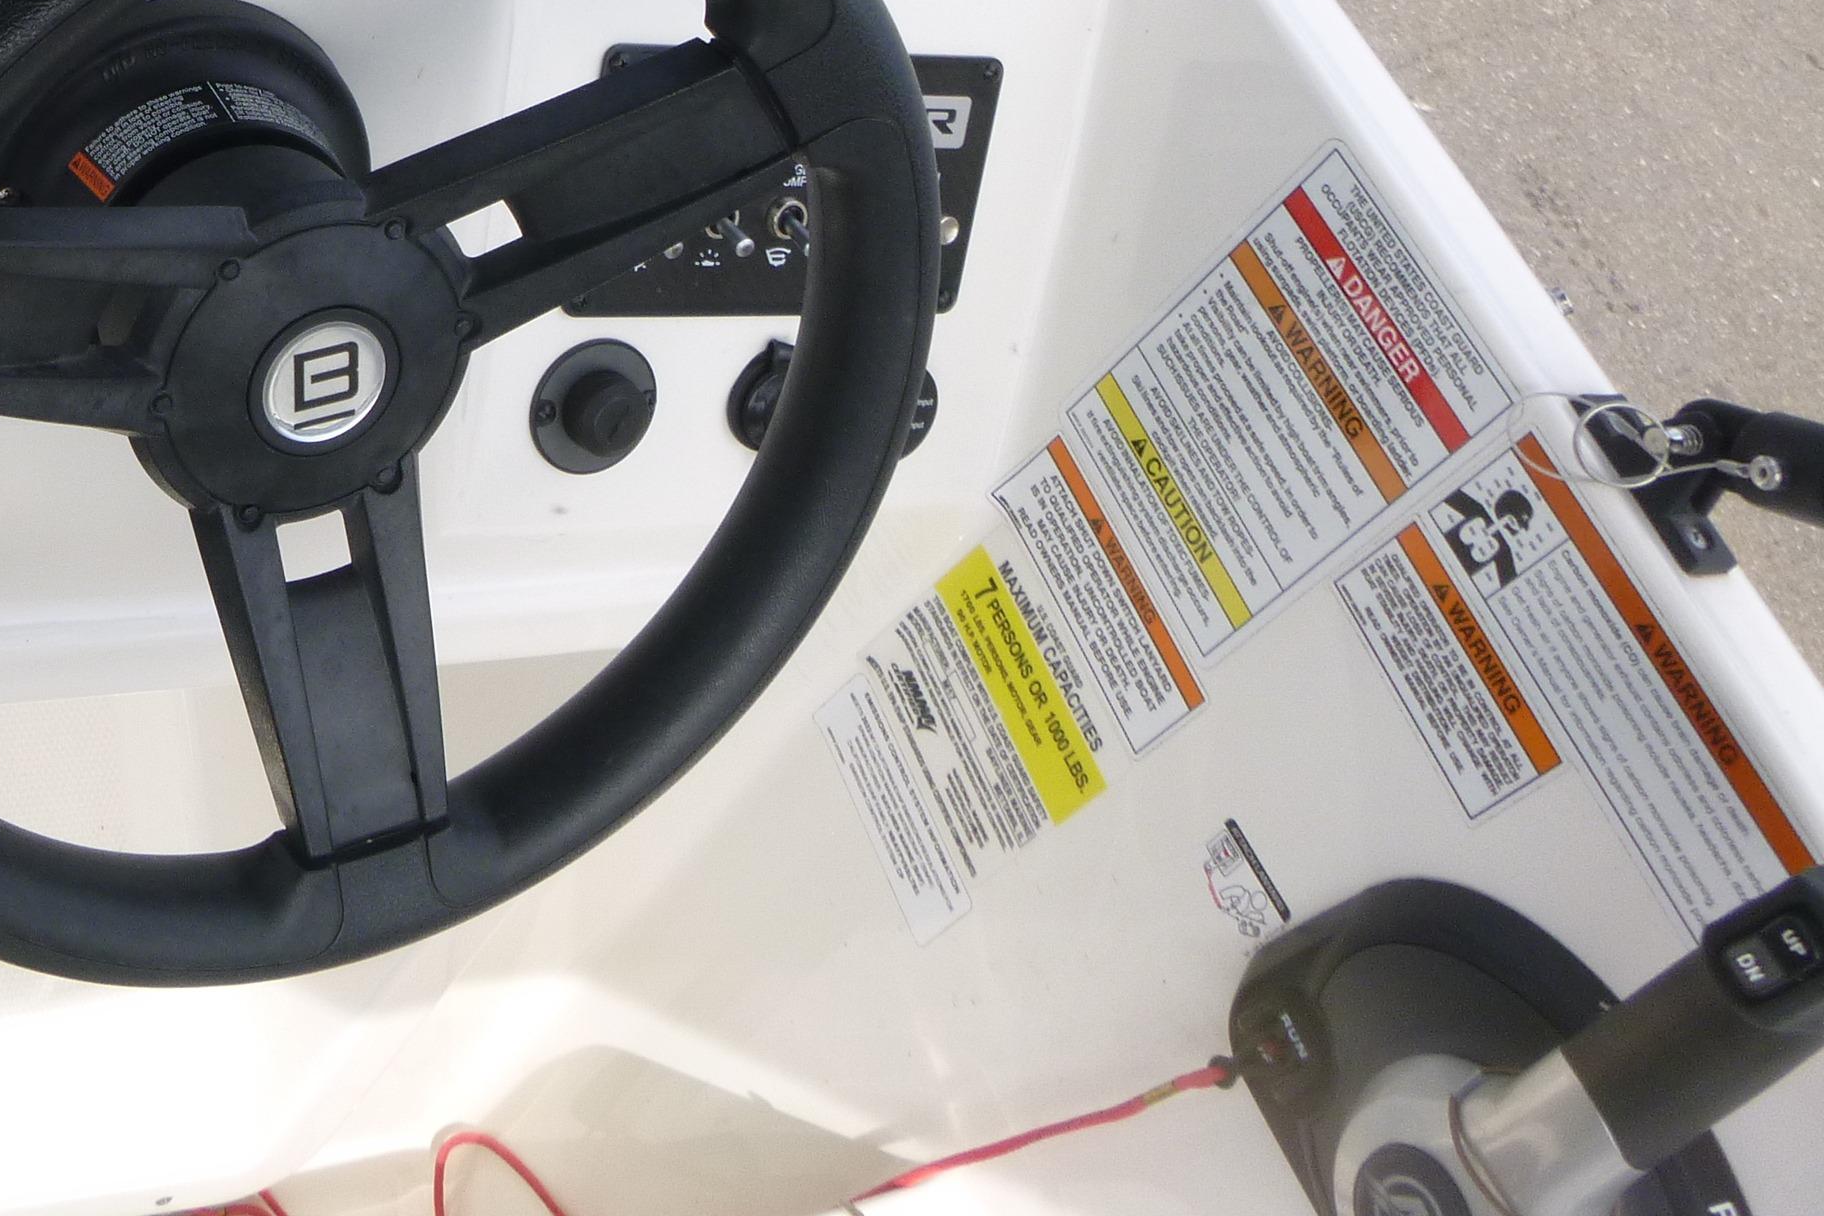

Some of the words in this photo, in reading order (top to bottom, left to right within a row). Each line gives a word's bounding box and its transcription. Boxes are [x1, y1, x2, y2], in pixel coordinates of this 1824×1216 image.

[1293, 235, 1351, 318] PROPELLER(S)
[1345, 313, 1367, 341] MAY
[1361, 336, 1393, 380] CAUSE
[1386, 374, 1426, 428] SERIOUS
[1315, 289, 1346, 331] INJURY
[1340, 327, 1357, 348] OR
[1319, 183, 1369, 251] OCCUPANTS
[1365, 249, 1392, 285] WEAR
[1389, 284, 1435, 347] APPROVED
[1431, 345, 1479, 410] PERSONAL
[1336, 227, 1381, 290] FLOTATION
[1376, 287, 1415, 339] DEVICES
[1341, 274, 1422, 384] DANGER
[1345, 200, 1376, 241] (USCG)
[1372, 238, 1431, 320] RECOMMENDS
[1427, 318, 1453, 351] THAT
[1448, 350, 1470, 376] ALL
[1348, 184, 1369, 210] THE
[1365, 208, 1397, 251] UNITED
[1392, 248, 1426, 292] STATES
[1422, 290, 1454, 332] COAST
[1450, 330, 1484, 376] GUARD
[1265, 328, 1291, 365] AVOID
[1283, 322, 1366, 440] WARNING
[1102, 417, 1124, 452] AVOID
[1120, 449, 1161, 515] INHALATION
[1156, 511, 1169, 528] OF
[1165, 527, 1188, 561] TOXIC
[1143, 454, 1213, 564] CAUTION
[1150, 385, 1172, 419] AVOID
[1168, 416, 1183, 438] SKI
[1179, 434, 1201, 467] LINES
[1198, 466, 1215, 491] AND
[1212, 489, 1231, 517] TOW
[972, 575, 998, 604] 7
[1016, 507, 1037, 539] READ
[1061, 590, 1091, 641] MANUAL
[1088, 641, 1118, 691] BEFORE
[1029, 484, 1040, 498] IS
[1036, 496, 1047, 511] IN
[1082, 582, 1138, 678] UNCONTROLLED
[1134, 678, 1157, 713] BOAT
[1036, 518, 1053, 544] MAY
[1049, 543, 1075, 584] CAUSE
[1071, 584, 1097, 626] INJURY
[1094, 626, 1108, 646] OR
[1038, 477, 1051, 494] TO
[1047, 493, 1084, 555] QUALIFIED
[1080, 554, 1119, 619] OPERATOR
[1115, 618, 1140, 657] WHILE
[1136, 657, 1166, 705] ENGINE
[1049, 473, 1077, 518] ATTACH
[1074, 518, 1094, 549] SHUT
[1091, 550, 1115, 588] DOWN
[1111, 587, 1141, 635] SWITCH
[1137, 634, 1172, 693] LANYARD
[1104, 537, 1157, 626] WARNING
[986, 598, 1033, 680] PERSONS
[1026, 678, 1048, 709] OR
[1043, 711, 1070, 753] 1000
[1062, 750, 1090, 794] LBS.
[997, 560, 1047, 645] MAXIMUM
[1041, 645, 1103, 753] CAPACITIES
[1045, 622, 1063, 651] COAST
[1060, 651, 1083, 689] GUARD
[1446, 601, 1522, 715] WARNING
[1650, 641, 1740, 767] WARNING
[1737, 953, 1766, 982] DN
[1782, 928, 1807, 956] UP
[1280, 1012, 1309, 1059] RUN
